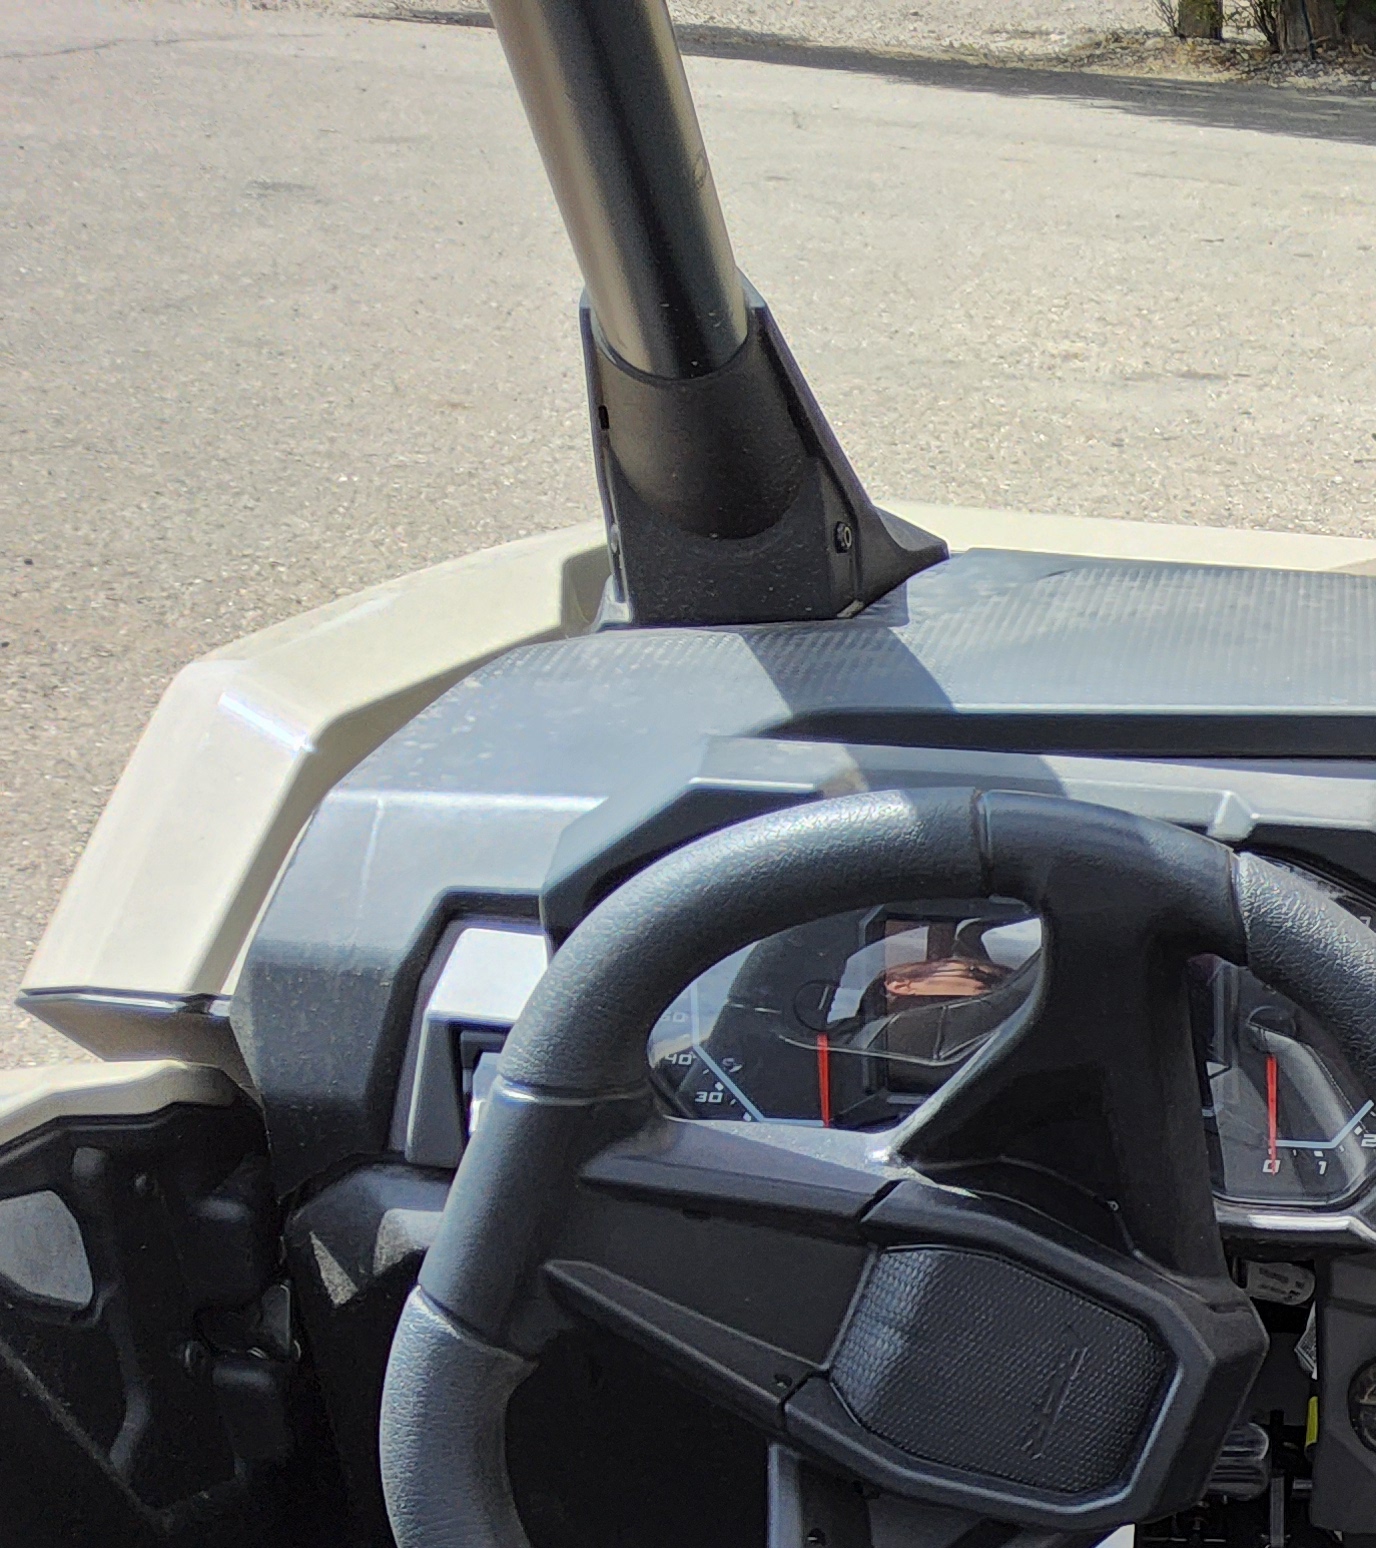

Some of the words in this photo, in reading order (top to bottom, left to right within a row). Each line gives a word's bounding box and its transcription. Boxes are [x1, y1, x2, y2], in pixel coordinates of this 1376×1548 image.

[665, 1053, 692, 1065] 40
[695, 1091, 723, 1103] 30
[1262, 1159, 1281, 1173] 0
[1317, 1160, 1328, 1175] 1
